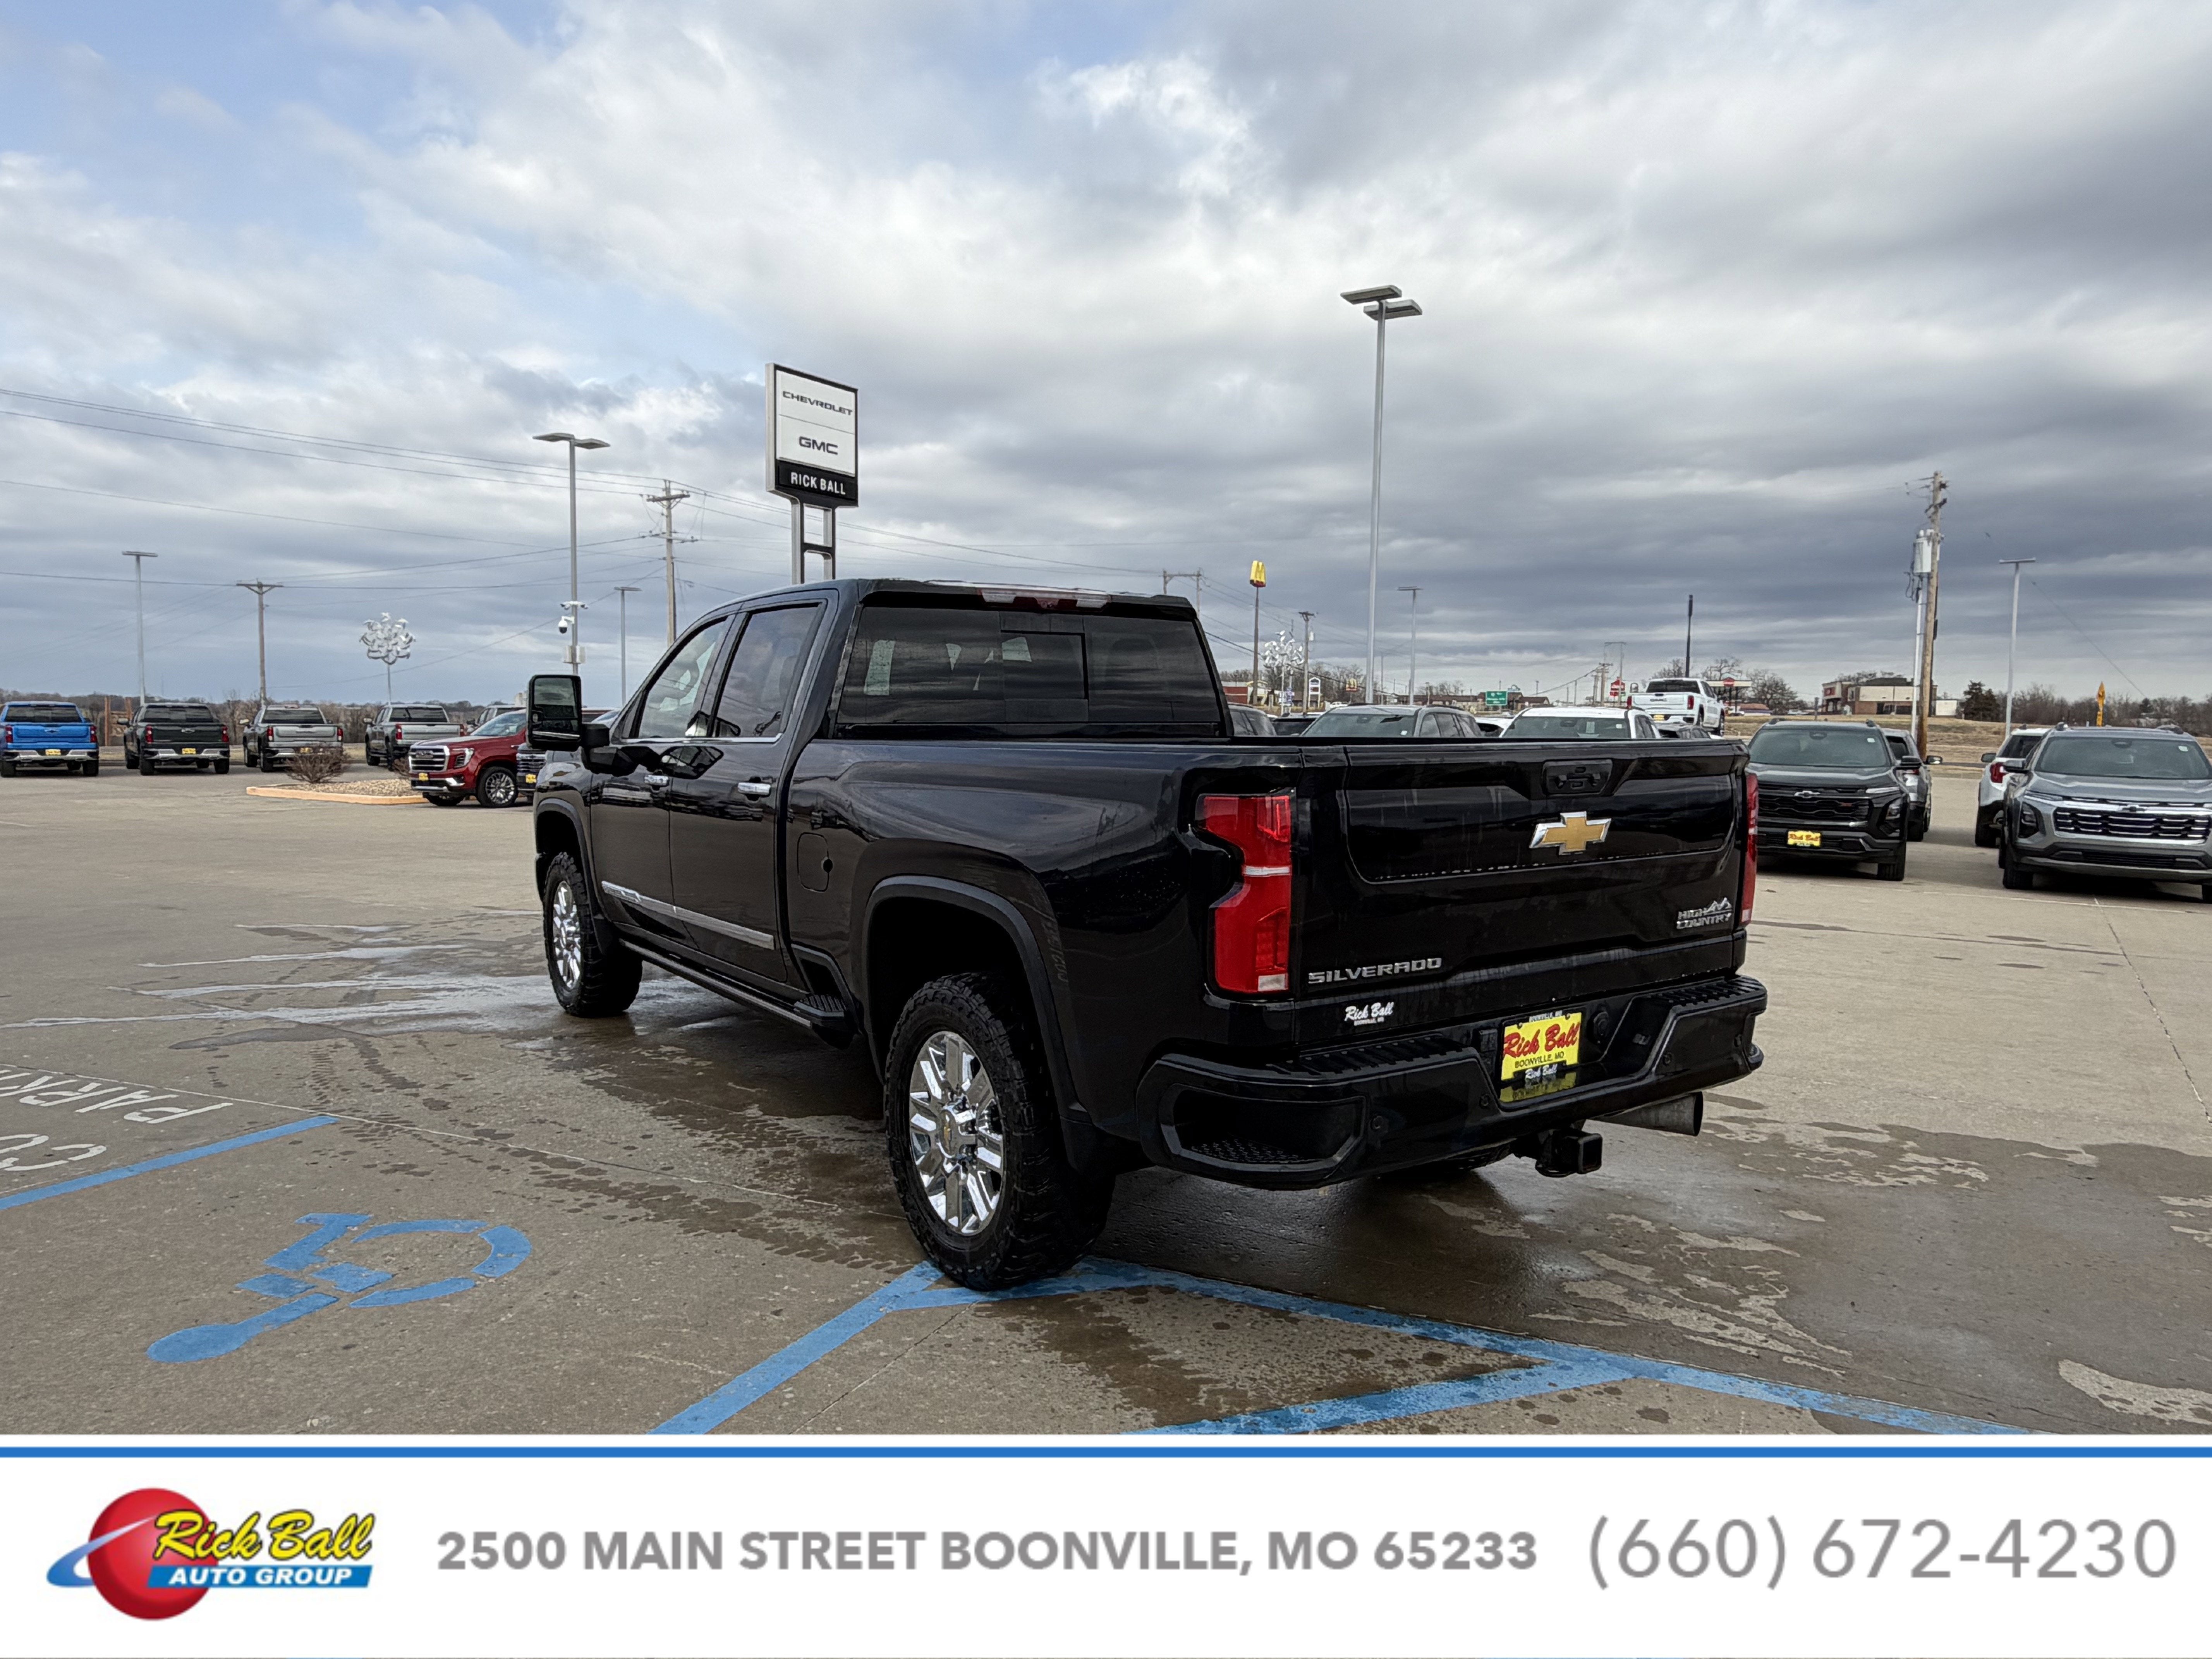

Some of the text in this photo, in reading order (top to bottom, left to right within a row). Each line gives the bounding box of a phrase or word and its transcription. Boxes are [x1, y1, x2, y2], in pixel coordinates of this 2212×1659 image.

[782, 391, 853, 416] CHEVROLET
[799, 436, 838, 455] GMC
[791, 472, 846, 495] RICK BALL
[1676, 913, 1732, 929] COUNTRY
[1308, 957, 1442, 984] SILVERADO
[1344, 1005, 1369, 1022] Rick
[1371, 1001, 1394, 1017] Ball
[1503, 1023, 1581, 1058] Rick Ball
